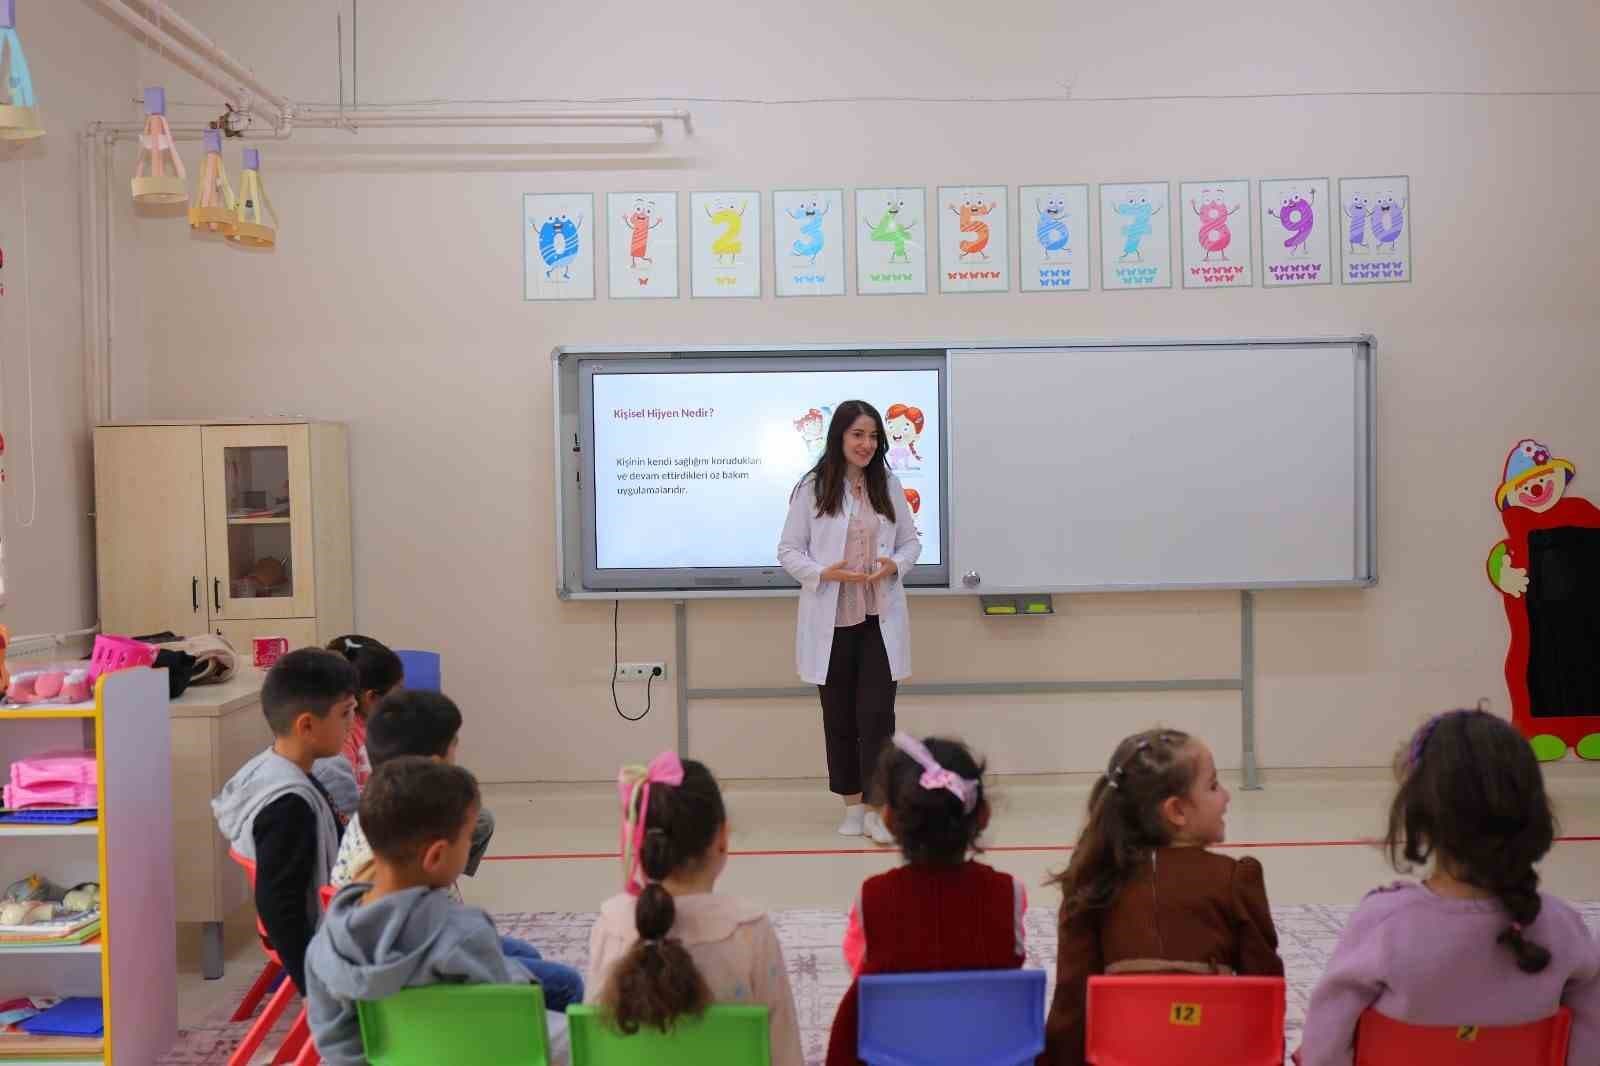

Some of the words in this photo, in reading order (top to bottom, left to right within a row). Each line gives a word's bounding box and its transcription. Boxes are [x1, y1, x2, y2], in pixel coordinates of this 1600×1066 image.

[711, 209, 743, 254] 2
[792, 208, 824, 256] 3
[870, 205, 912, 257] 4
[959, 202, 990, 254] 5
[1036, 197, 1070, 251] 6
[1118, 203, 1152, 254] 7
[1199, 201, 1232, 251] 8
[1280, 198, 1314, 248] 9
[1349, 200, 1404, 245] 10
[613, 408, 645, 421] Kişisel
[647, 408, 679, 421] Hijyen
[681, 407, 714, 419] Nedir?
[617, 473, 629, 481] ve
[630, 471, 660, 481] devam
[647, 456, 672, 467] kendi
[1175, 1006, 1195, 1021] 12
